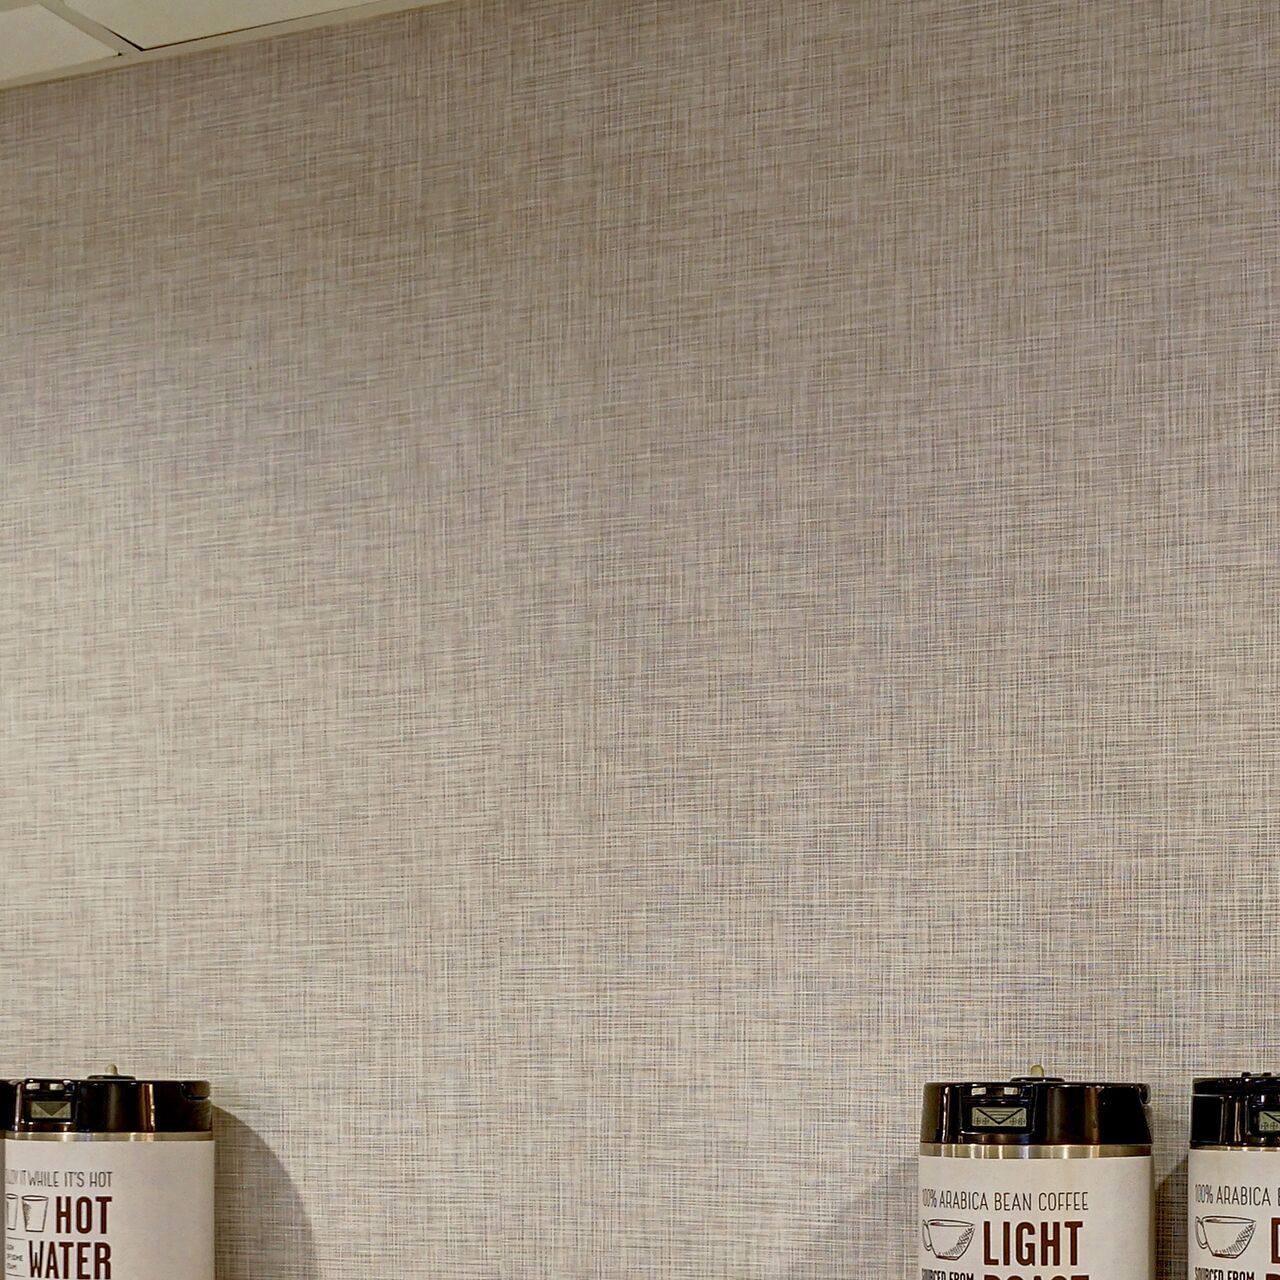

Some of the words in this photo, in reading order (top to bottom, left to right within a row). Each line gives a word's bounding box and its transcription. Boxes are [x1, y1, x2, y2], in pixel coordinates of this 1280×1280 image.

[28, 1170, 60, 1188] WHILE
[64, 1171, 85, 1188] IT'S
[90, 1171, 112, 1188] HOT
[939, 1191, 988, 1211] ARABICA
[994, 1192, 1032, 1211] BEAN
[1038, 1192, 1089, 1212] COFFEE
[1216, 1186, 1271, 1206] ARABICA
[55, 1196, 113, 1234] HOT
[983, 1221, 1084, 1266] LIGHT
[28, 1240, 112, 1280] WATER
